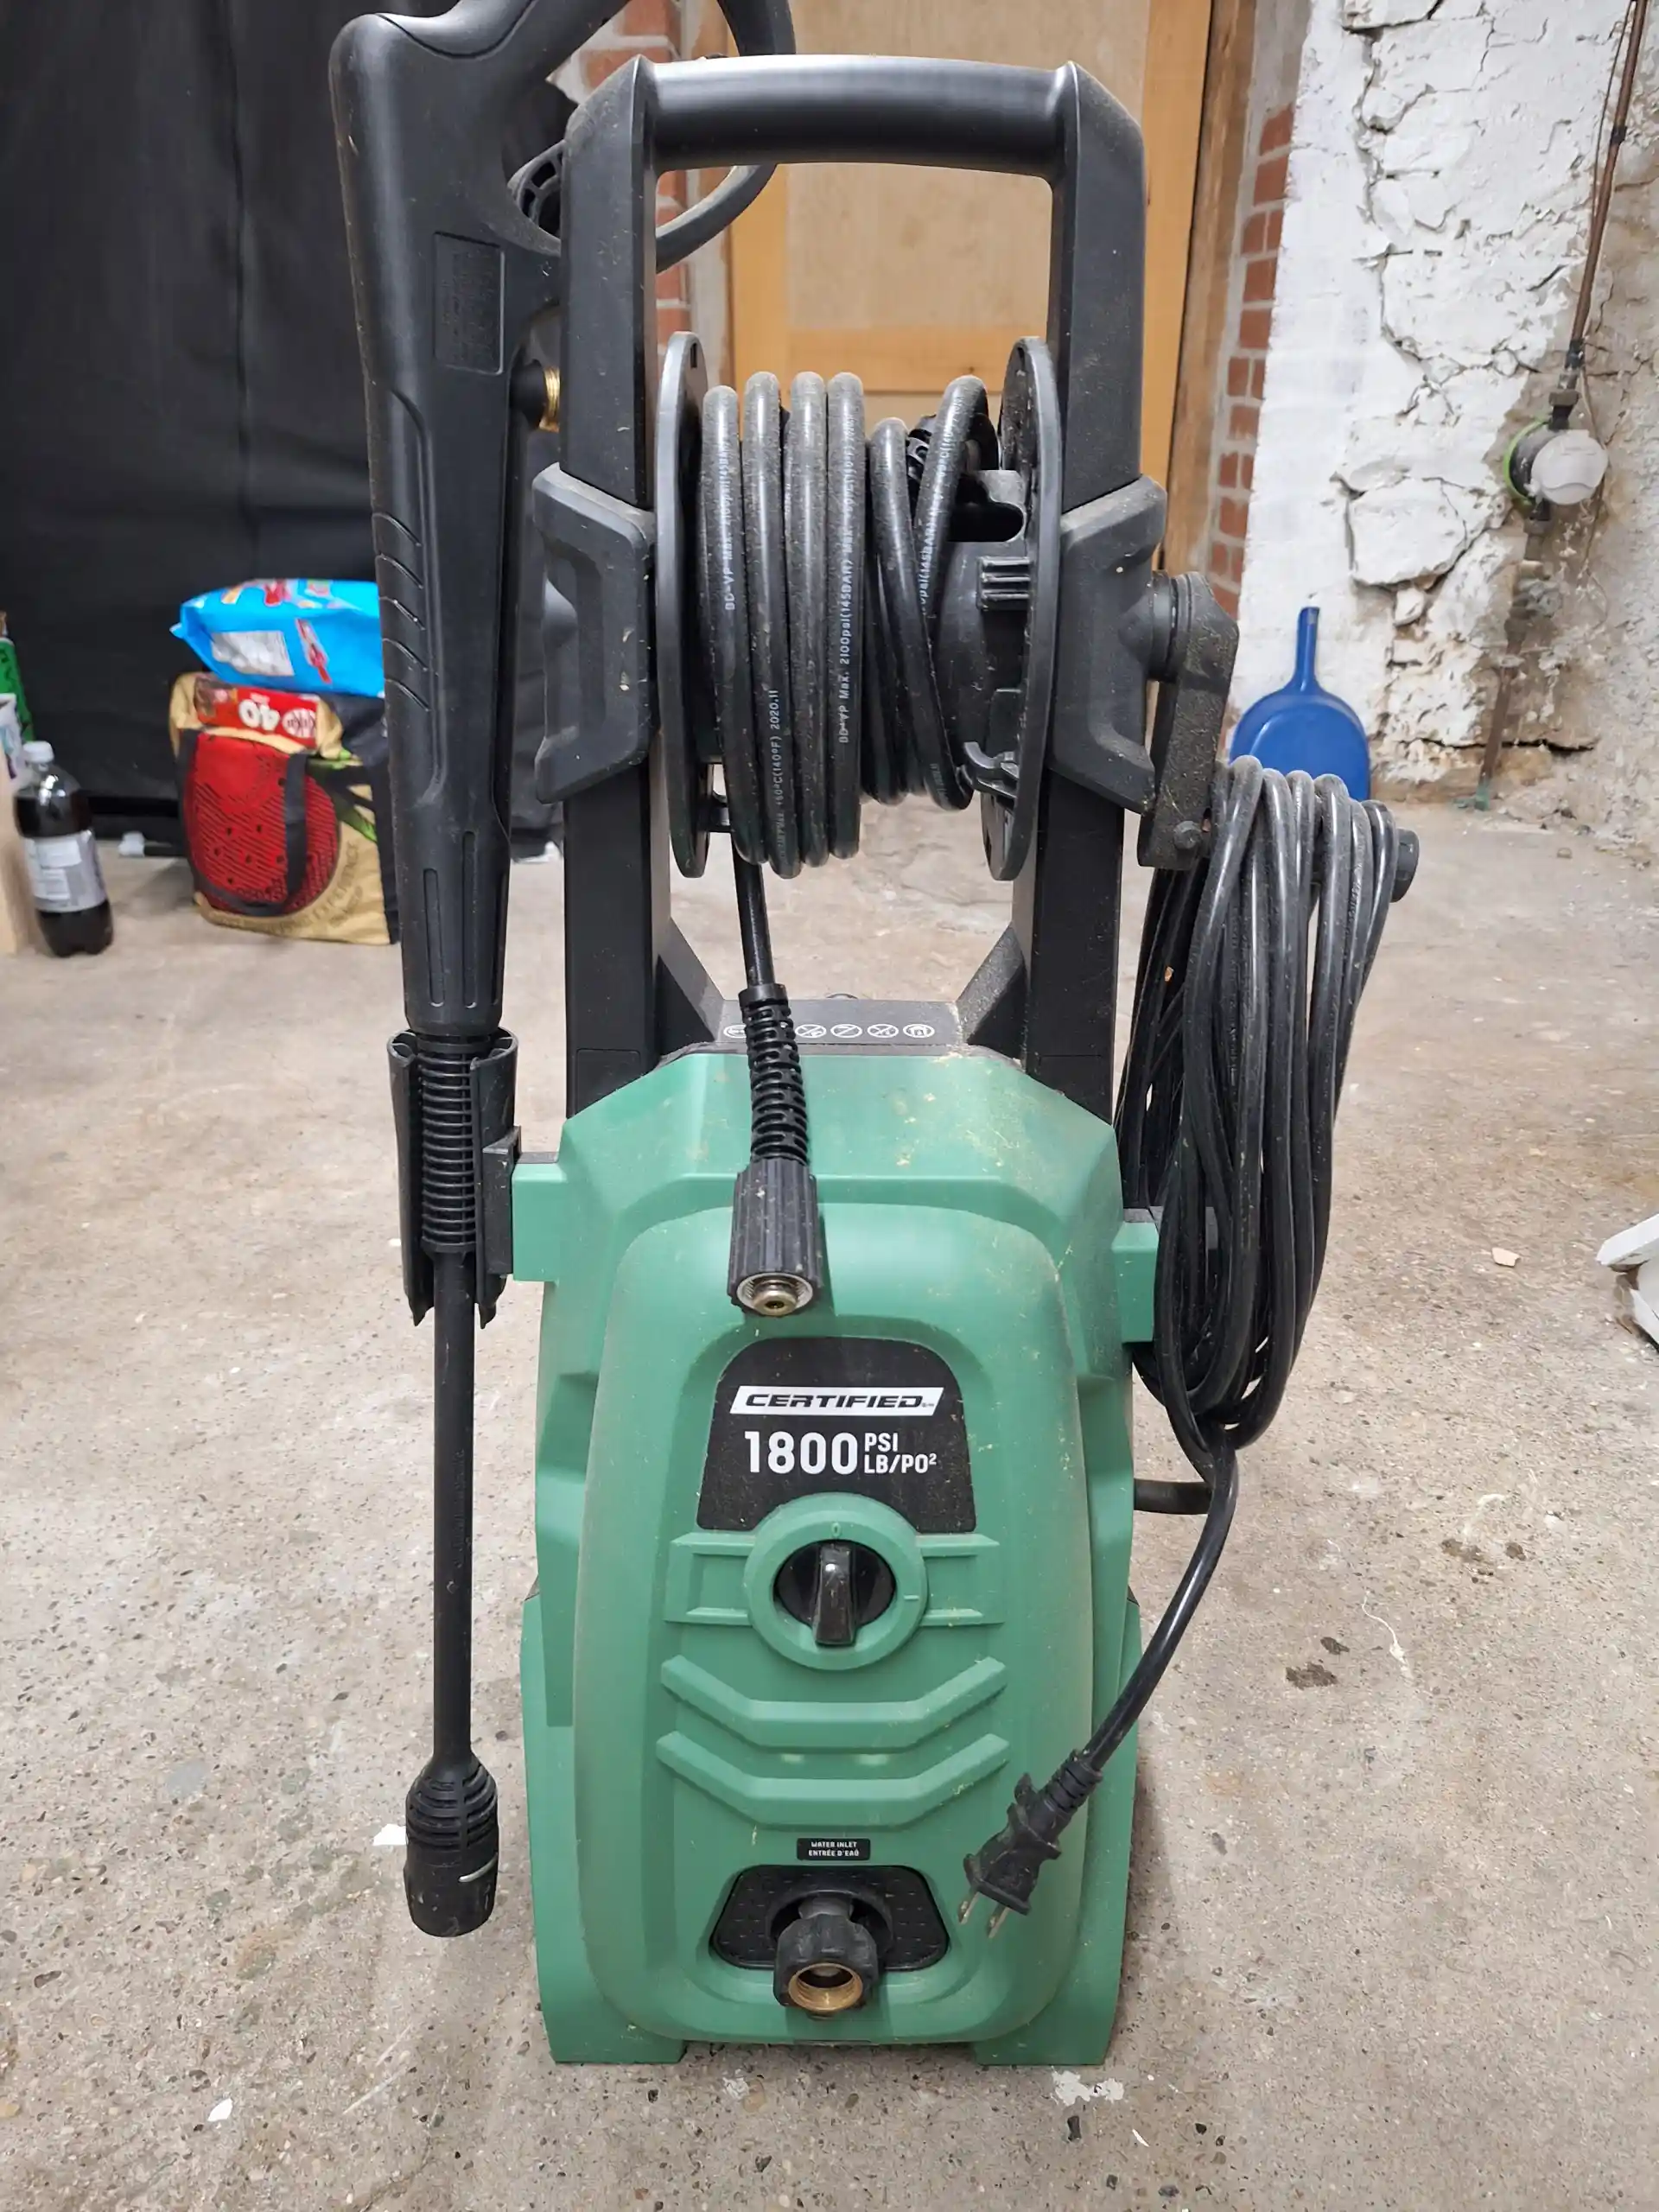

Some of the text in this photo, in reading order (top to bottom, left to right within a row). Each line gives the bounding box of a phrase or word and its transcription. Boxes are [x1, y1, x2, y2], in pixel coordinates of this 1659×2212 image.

[837, 671, 850, 700] Max.
[238, 697, 281, 732] 40
[768, 690, 780, 730] 2020.11
[746, 1394, 923, 1408] CERTIFIED
[744, 1431, 899, 1475] 1800 PSI
